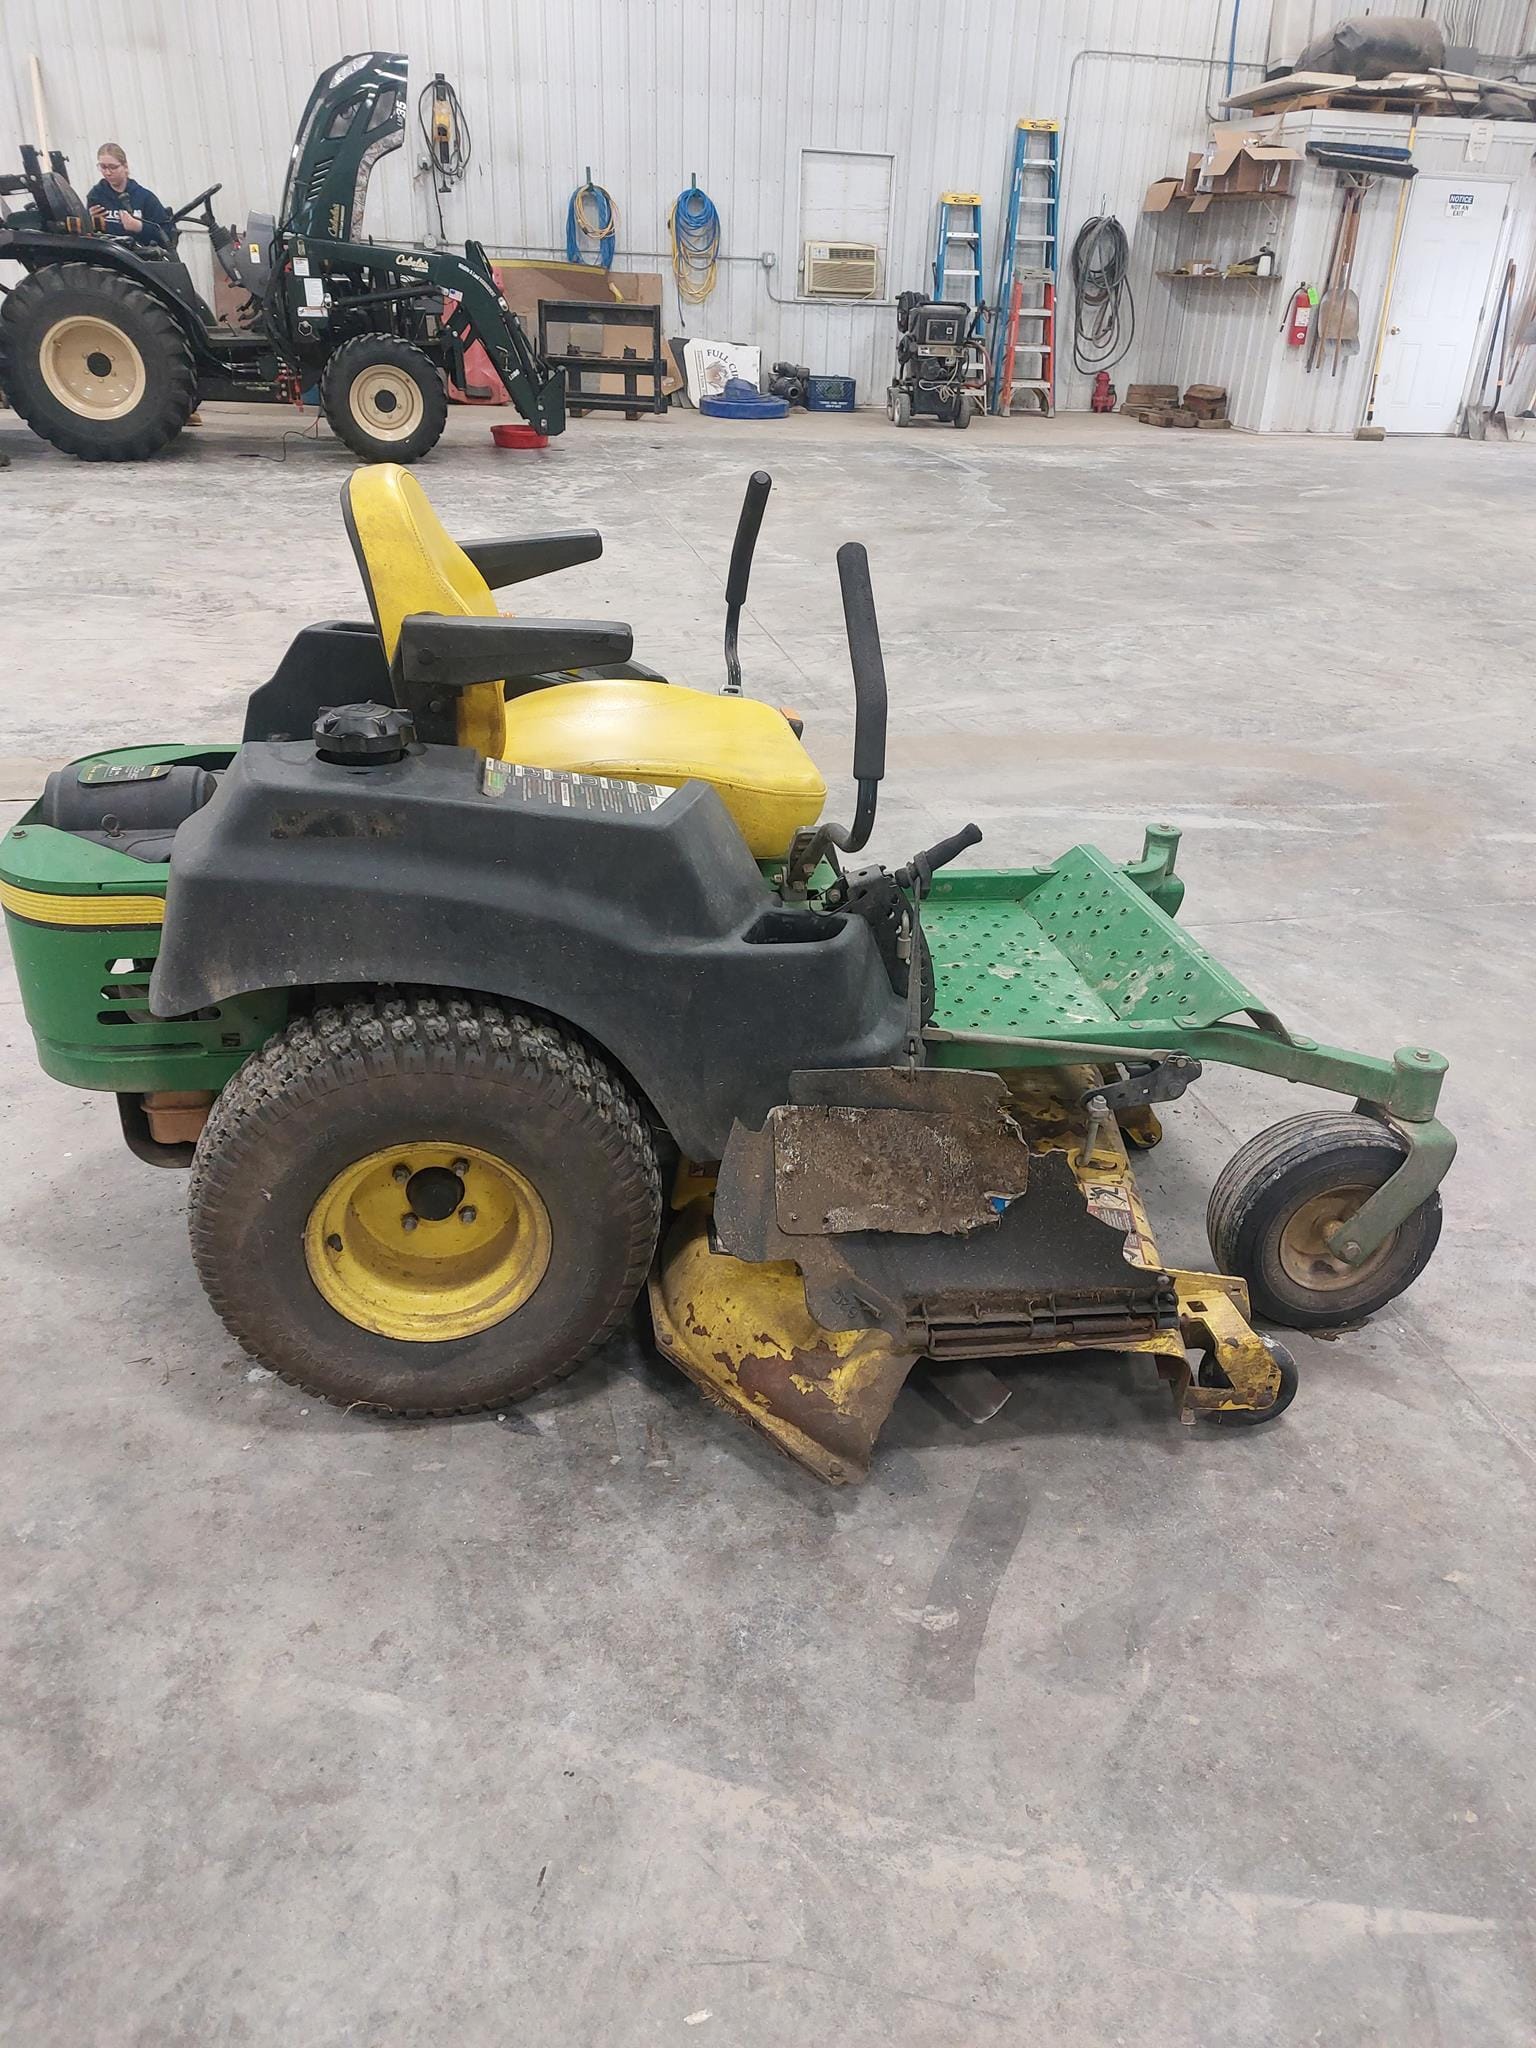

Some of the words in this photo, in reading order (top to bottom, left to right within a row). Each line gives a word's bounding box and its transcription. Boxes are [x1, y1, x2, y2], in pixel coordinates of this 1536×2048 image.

[1449, 195, 1473, 204] NOTICE
[395, 254, 429, 269] Cabela's
[707, 349, 729, 363] FULL
